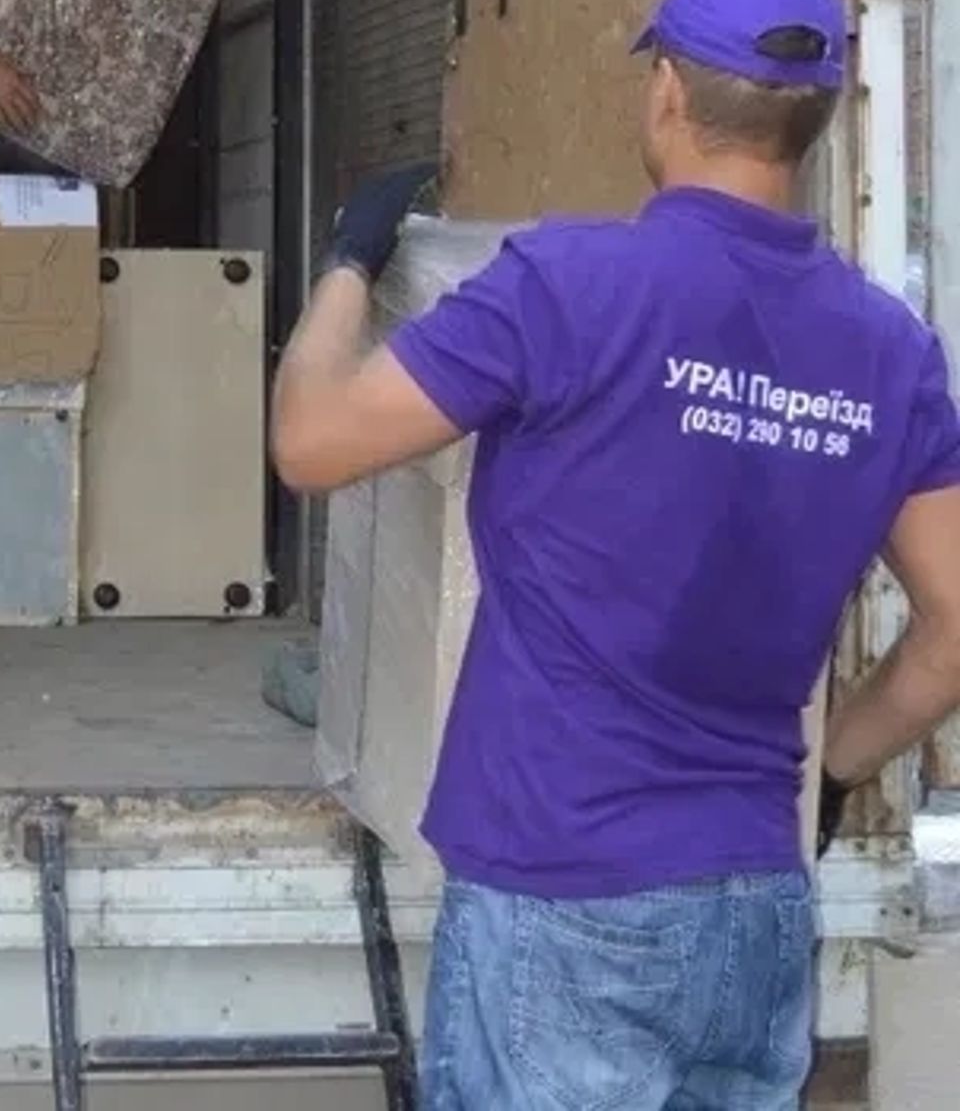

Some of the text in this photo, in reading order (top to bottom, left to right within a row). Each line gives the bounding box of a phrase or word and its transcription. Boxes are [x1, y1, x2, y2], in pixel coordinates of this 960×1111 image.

[663, 356, 873, 435] УРА! Переїзд
[681, 405, 742, 442] (032)
[790, 426, 819, 452] 10
